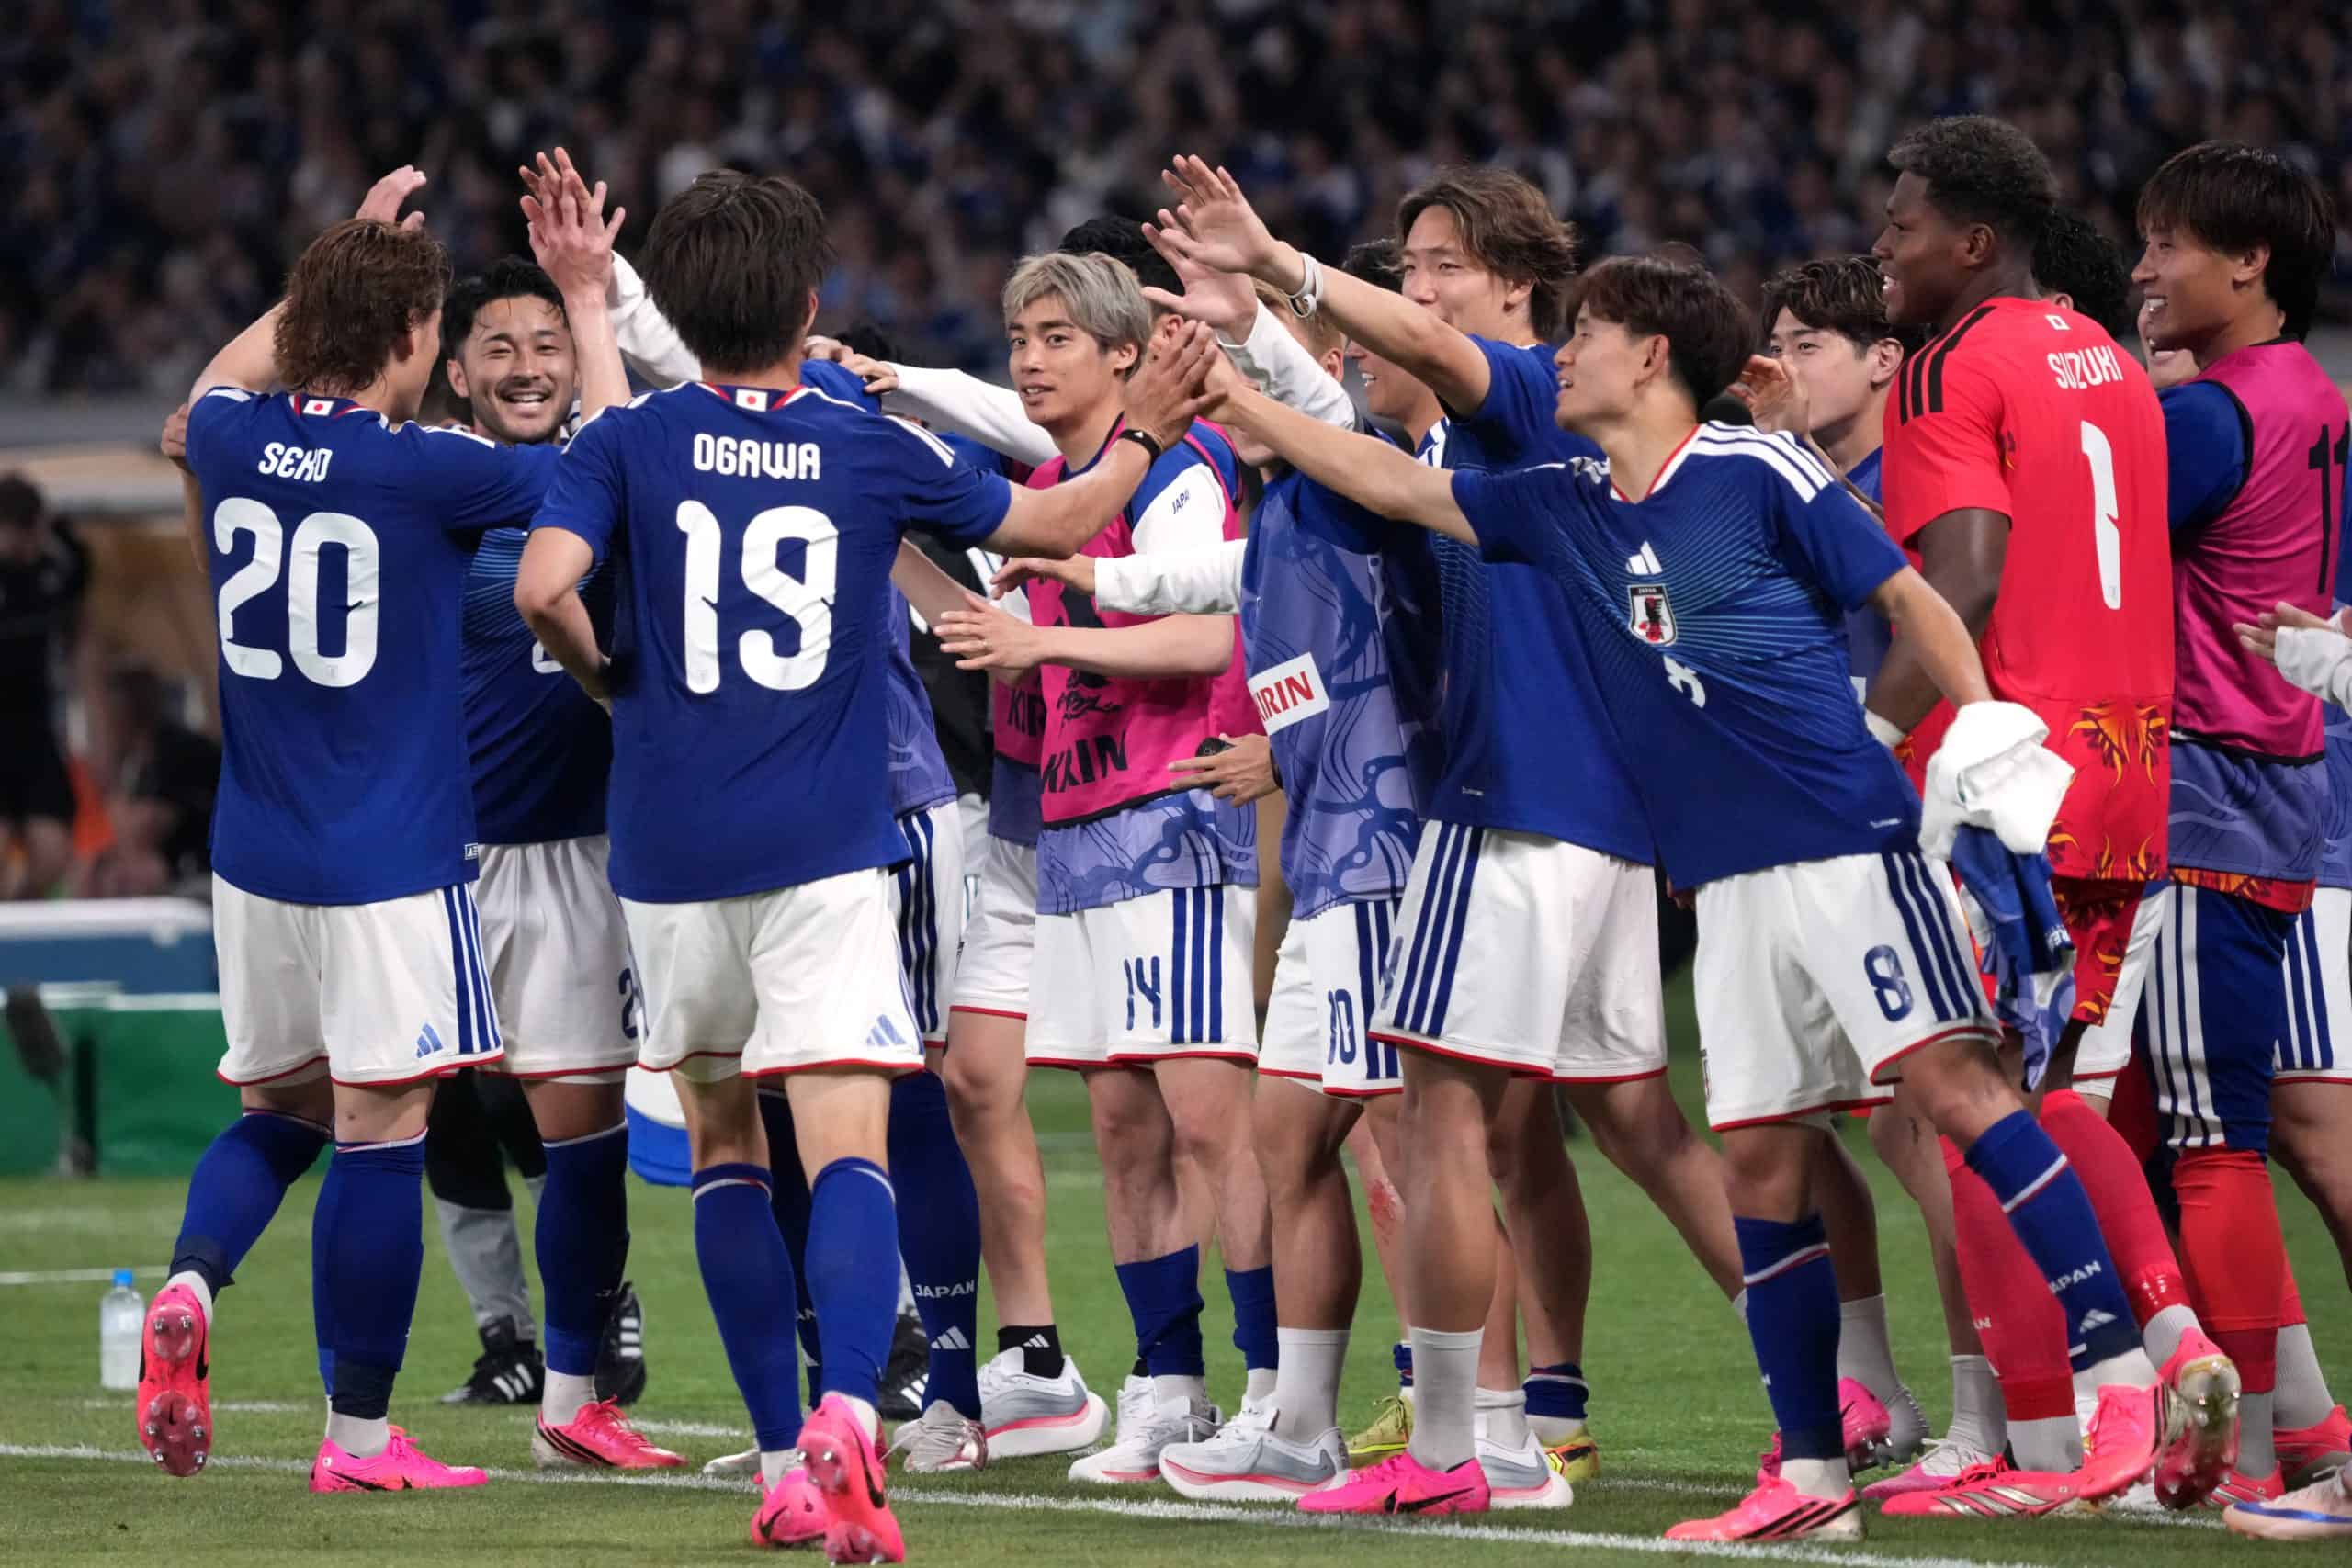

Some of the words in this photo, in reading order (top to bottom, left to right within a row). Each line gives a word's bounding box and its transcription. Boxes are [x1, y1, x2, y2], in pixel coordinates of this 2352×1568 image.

[2046, 344, 2124, 389] SUZUKI
[258, 441, 334, 483] SEKO
[694, 433, 820, 480] OGAWA
[2079, 419, 2121, 610] 1
[213, 496, 379, 688] 20
[676, 500, 839, 694] 19
[1124, 956, 1162, 1031] 14
[1863, 943, 1915, 1023] 8
[1327, 988, 1357, 1066] 10
[916, 1280, 976, 1299] JAPAN
[2050, 1260, 2103, 1294] APAN
